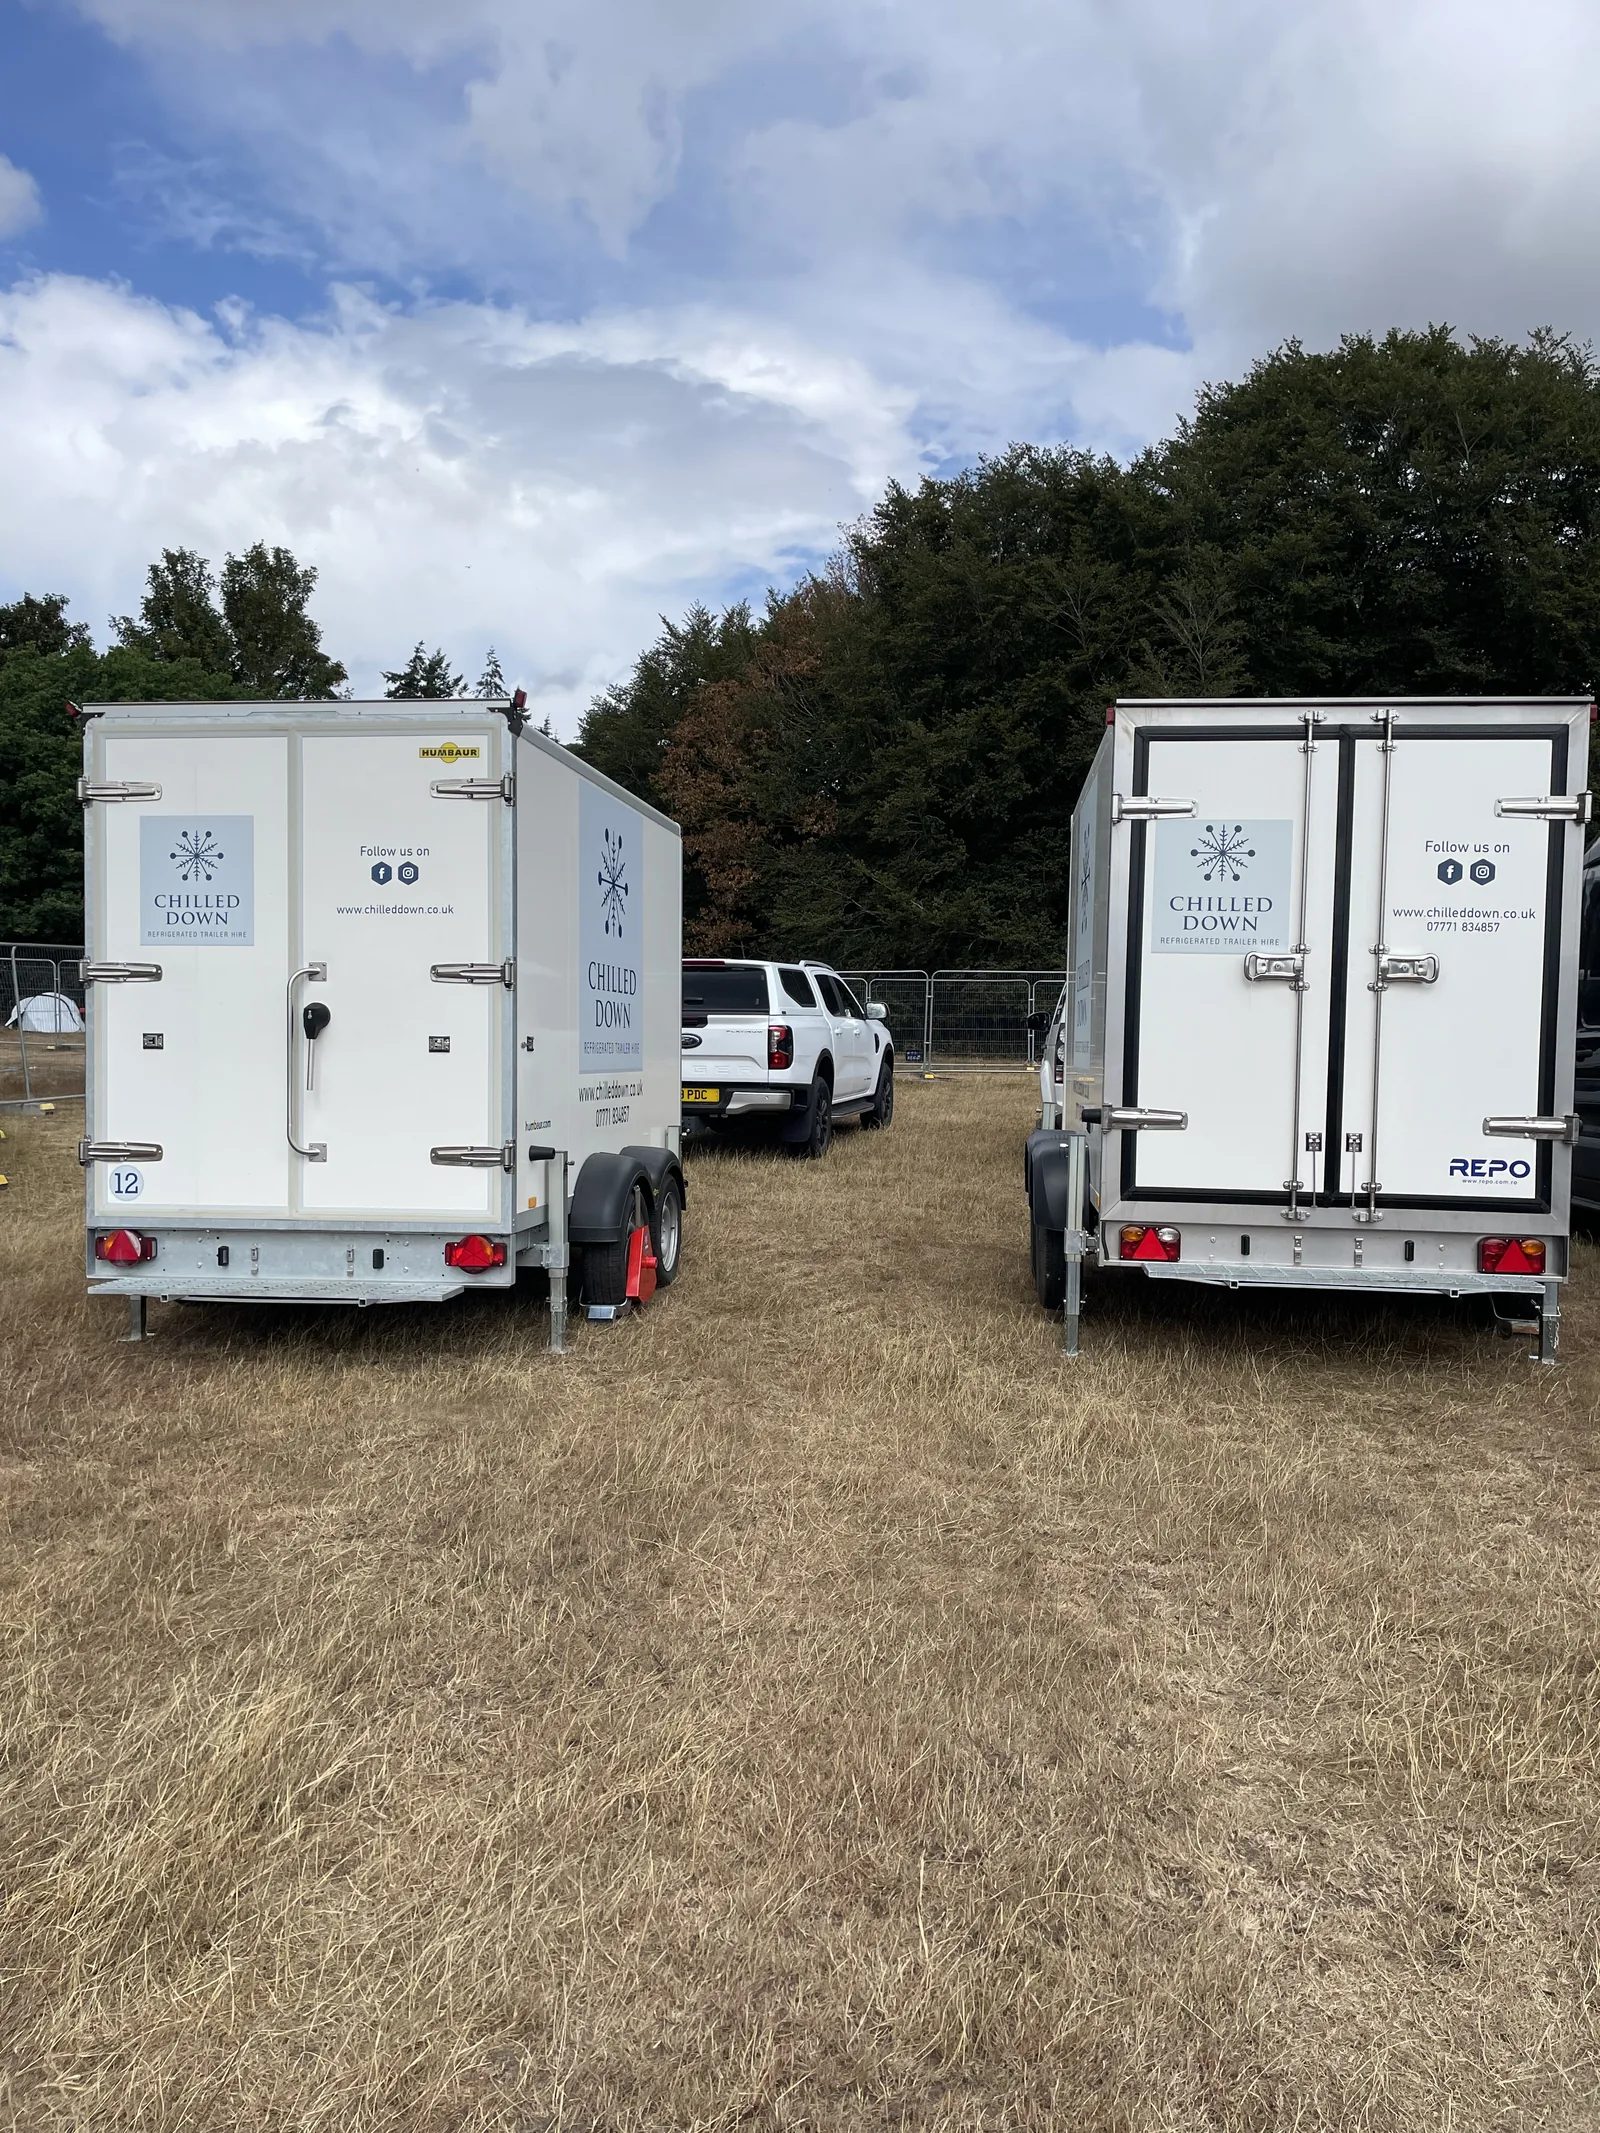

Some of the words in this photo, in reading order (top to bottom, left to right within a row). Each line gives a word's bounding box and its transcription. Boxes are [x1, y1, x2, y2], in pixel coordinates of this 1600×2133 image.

[421, 749, 477, 757] HUMBAUR
[360, 845, 396, 857] Follow
[399, 848, 413, 857] us
[416, 848, 430, 857] on
[1425, 840, 1470, 853] Follow
[1473, 843, 1490, 853] us
[1494, 843, 1510, 853] on
[154, 894, 240, 909] CHILLED
[1169, 895, 1273, 913] CHILLED
[336, 904, 454, 915] www.chilleddown.co.uk
[1392, 907, 1536, 919] www.chilleddown.co.uk
[165, 911, 228, 925] DOWN
[1182, 915, 1259, 932] DOWN
[1426, 921, 1457, 932] 07771
[1461, 922, 1500, 932] 834857
[147, 930, 198, 938] REFRIGERATED
[1160, 936, 1220, 945] REFRIGERATED
[1224, 937, 1257, 946] TRAILER
[1260, 938, 1280, 946] HIRE
[588, 961, 637, 996] CHILLED
[595, 999, 631, 1028] DOWN
[578, 1079, 644, 1103] www.chilleddown.co.uk
[687, 1089, 708, 1101] PDC
[595, 1106, 611, 1128] 07771
[612, 1105, 630, 1125] 834857
[1449, 1158, 1531, 1179] REPO
[114, 1172, 139, 1194] 12
[1462, 1178, 1518, 1186] www.repo.com.ro
